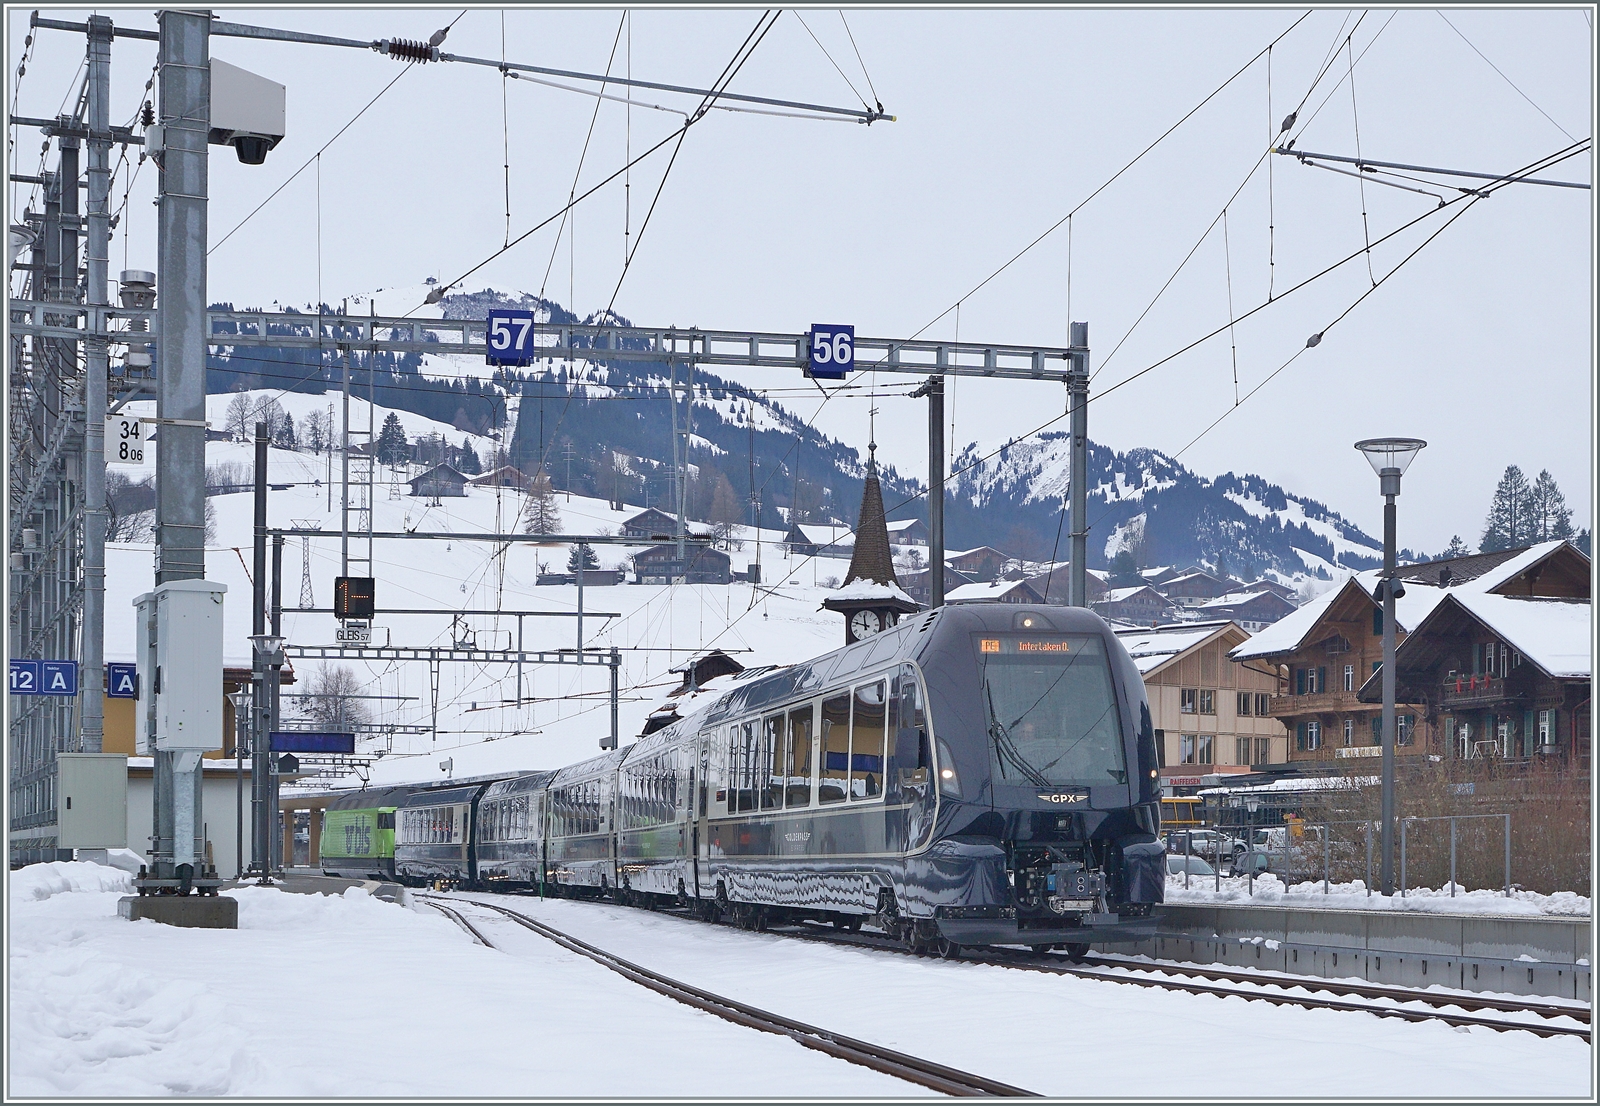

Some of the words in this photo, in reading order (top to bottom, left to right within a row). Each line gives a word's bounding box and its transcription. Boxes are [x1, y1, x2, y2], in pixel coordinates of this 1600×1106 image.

[490, 317, 532, 350] 57
[813, 332, 852, 364] 56
[120, 420, 140, 440] 34
[336, 630, 360, 641] GLEIS
[360, 633, 370, 641] 57
[9, 671, 33, 689] 12
[50, 672, 67, 690] A
[117, 674, 135, 692] A
[1169, 778, 1201, 786] RAIFFEISEN
[1050, 794, 1076, 803] GPX
